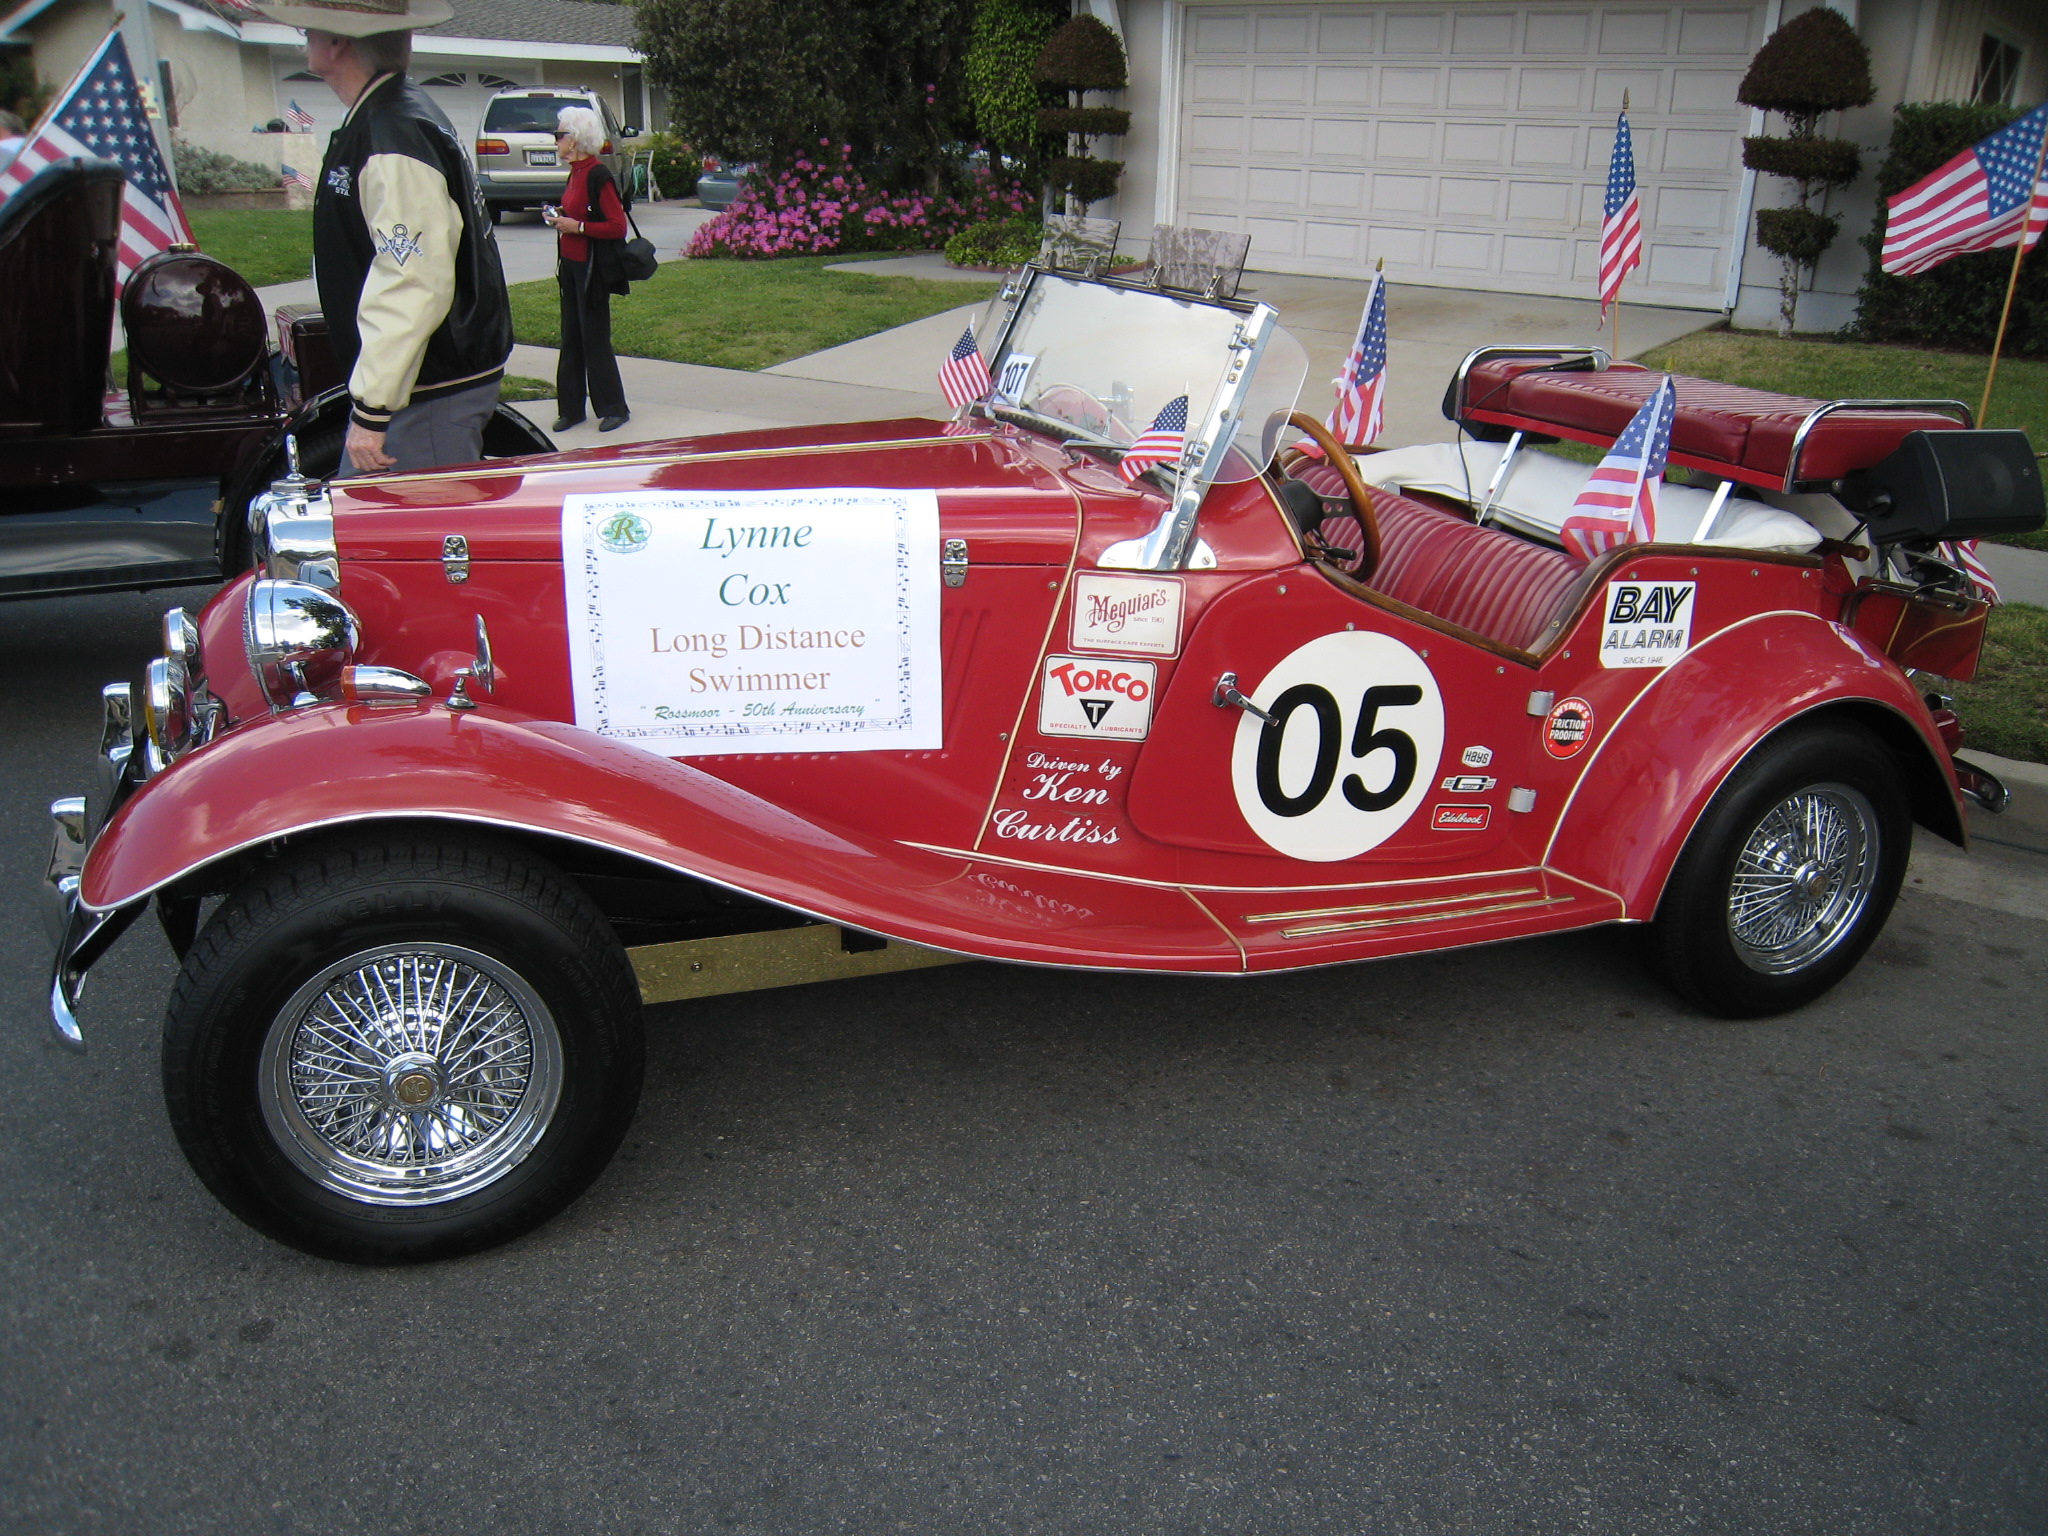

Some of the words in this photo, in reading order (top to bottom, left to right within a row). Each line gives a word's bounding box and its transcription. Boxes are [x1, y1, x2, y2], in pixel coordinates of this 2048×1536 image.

[1002, 361, 1029, 394] 107
[612, 515, 641, 543] R
[699, 517, 813, 559] Lynne
[718, 573, 791, 606] Cox
[1085, 589, 1167, 633] Meguiar's
[1608, 586, 1694, 624] BAY
[650, 626, 728, 659] Long
[738, 624, 866, 651] Distance
[1603, 629, 1684, 650] ALARM
[1622, 656, 1647, 665] SINCE
[689, 666, 831, 694] Swimmer
[1050, 662, 1149, 702] TORCO
[654, 705, 721, 720] Rossmoor
[742, 702, 776, 717] 50th
[779, 701, 865, 717] Anniversary
[1087, 702, 1106, 723] T
[1551, 718, 1587, 730] FRICTION
[1553, 701, 1590, 719] WYNN'S
[1049, 722, 1087, 731] SPECIALTY
[1100, 725, 1143, 734] LUBRICANTS
[1548, 729, 1585, 741] PROOFING
[1256, 683, 1423, 817] 05
[1026, 752, 1090, 773] Driven
[1097, 758, 1123, 781] by
[1022, 772, 1110, 805] Ken
[992, 808, 1121, 844] Curtiss
[1438, 811, 1483, 825] Edelbrock
[315, 889, 453, 930] KELLY
